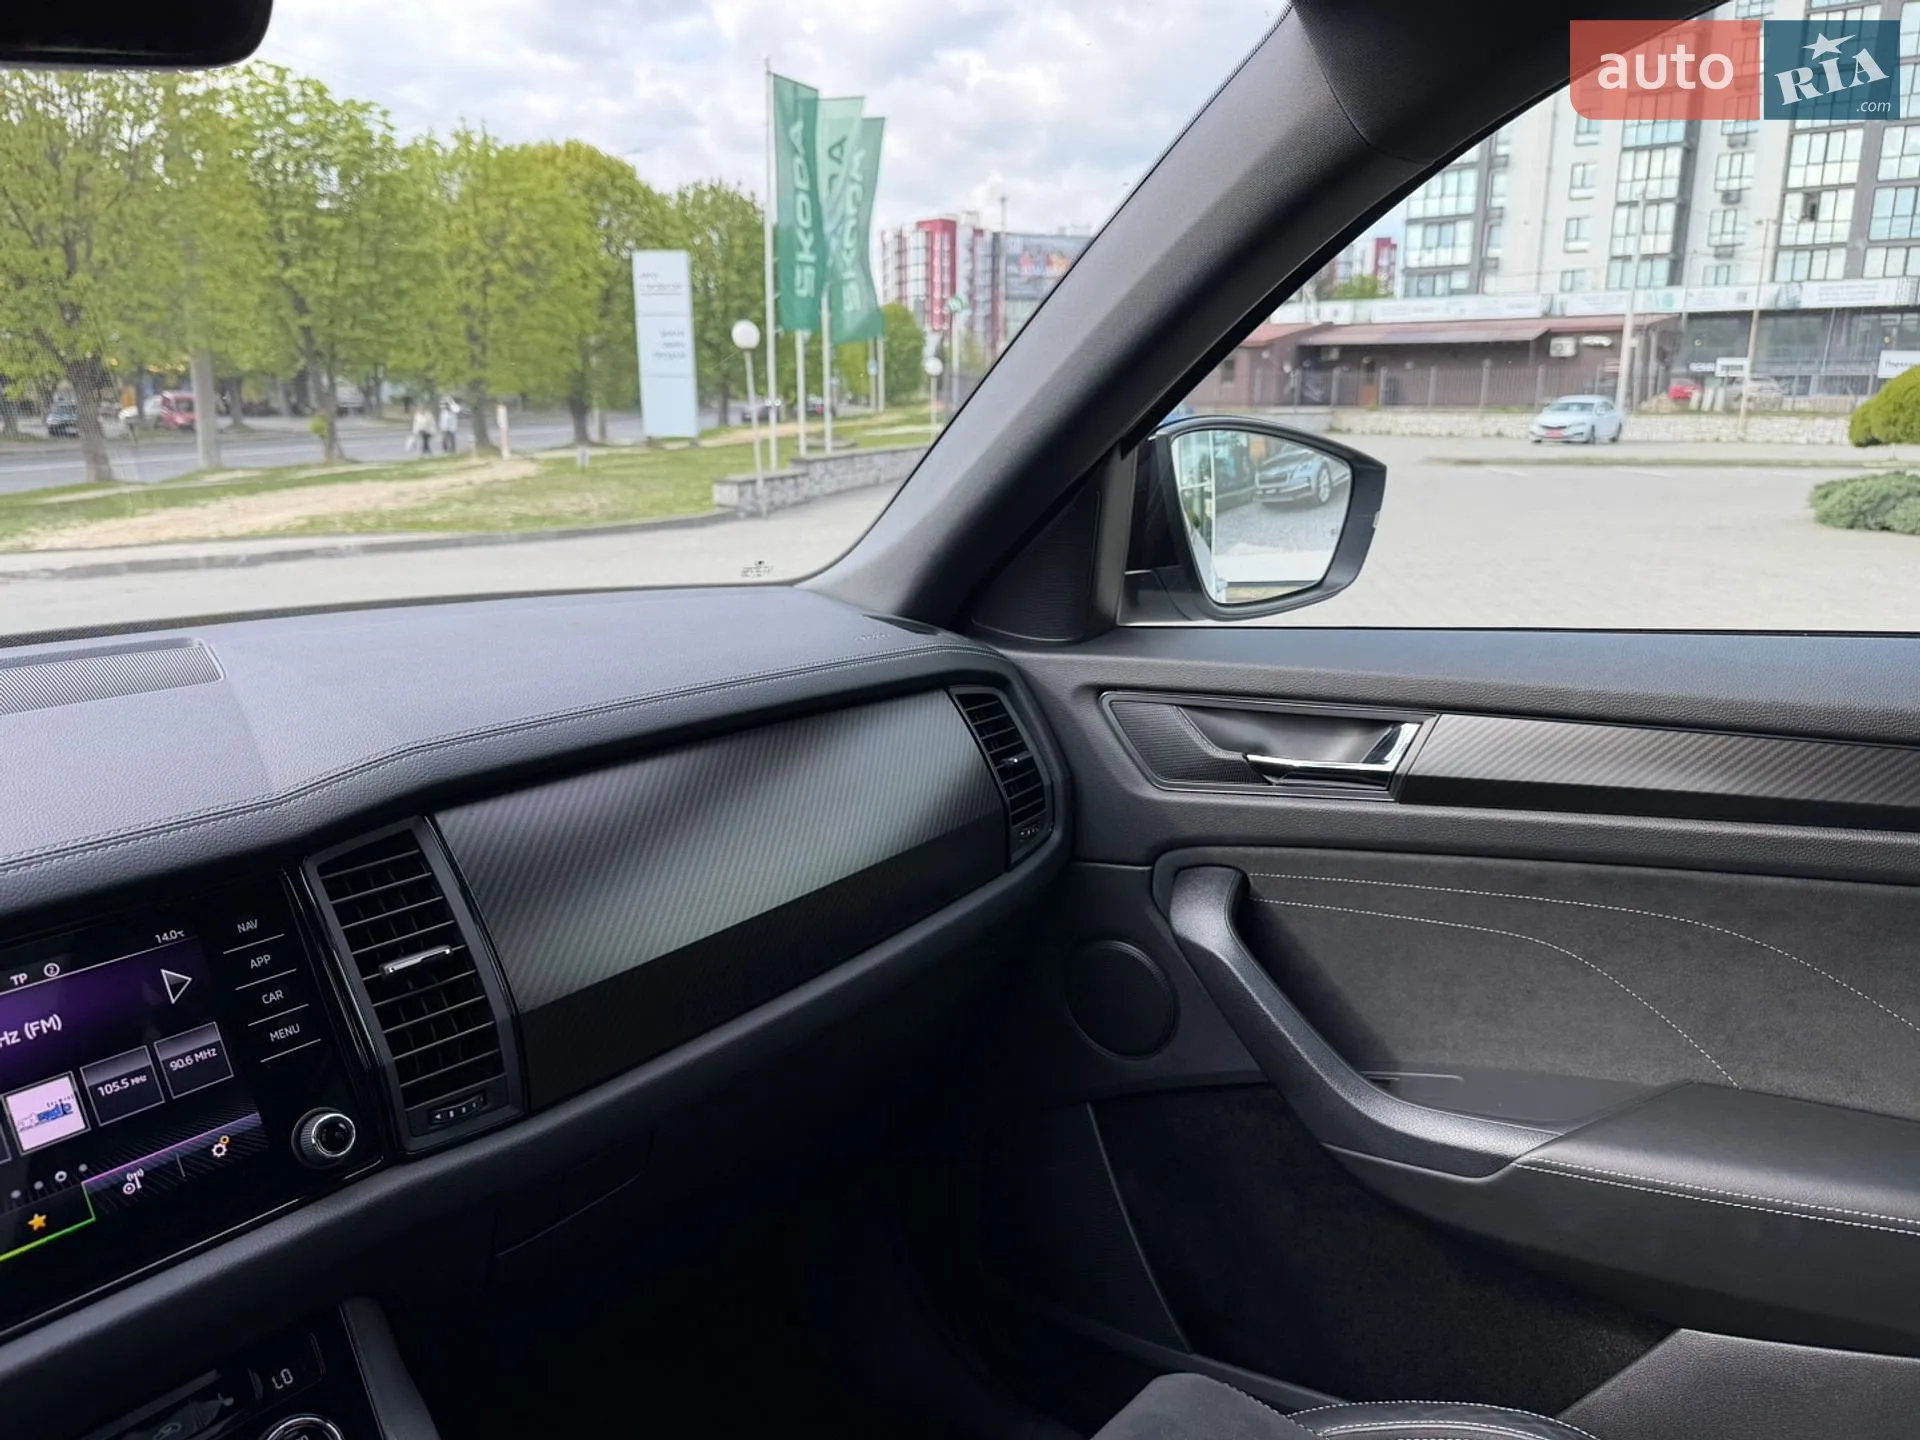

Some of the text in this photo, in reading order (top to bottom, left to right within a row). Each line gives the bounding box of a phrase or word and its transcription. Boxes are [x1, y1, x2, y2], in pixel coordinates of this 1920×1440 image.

[237, 919, 259, 933] NAV
[250, 954, 271, 969] APP
[10, 972, 28, 987] TP
[261, 989, 284, 1004] CAR
[24, 1013, 63, 1040] (FM)
[269, 1023, 300, 1042] MENU
[169, 1047, 218, 1071] 90.6 MHz
[97, 1080, 130, 1097] 105.5
